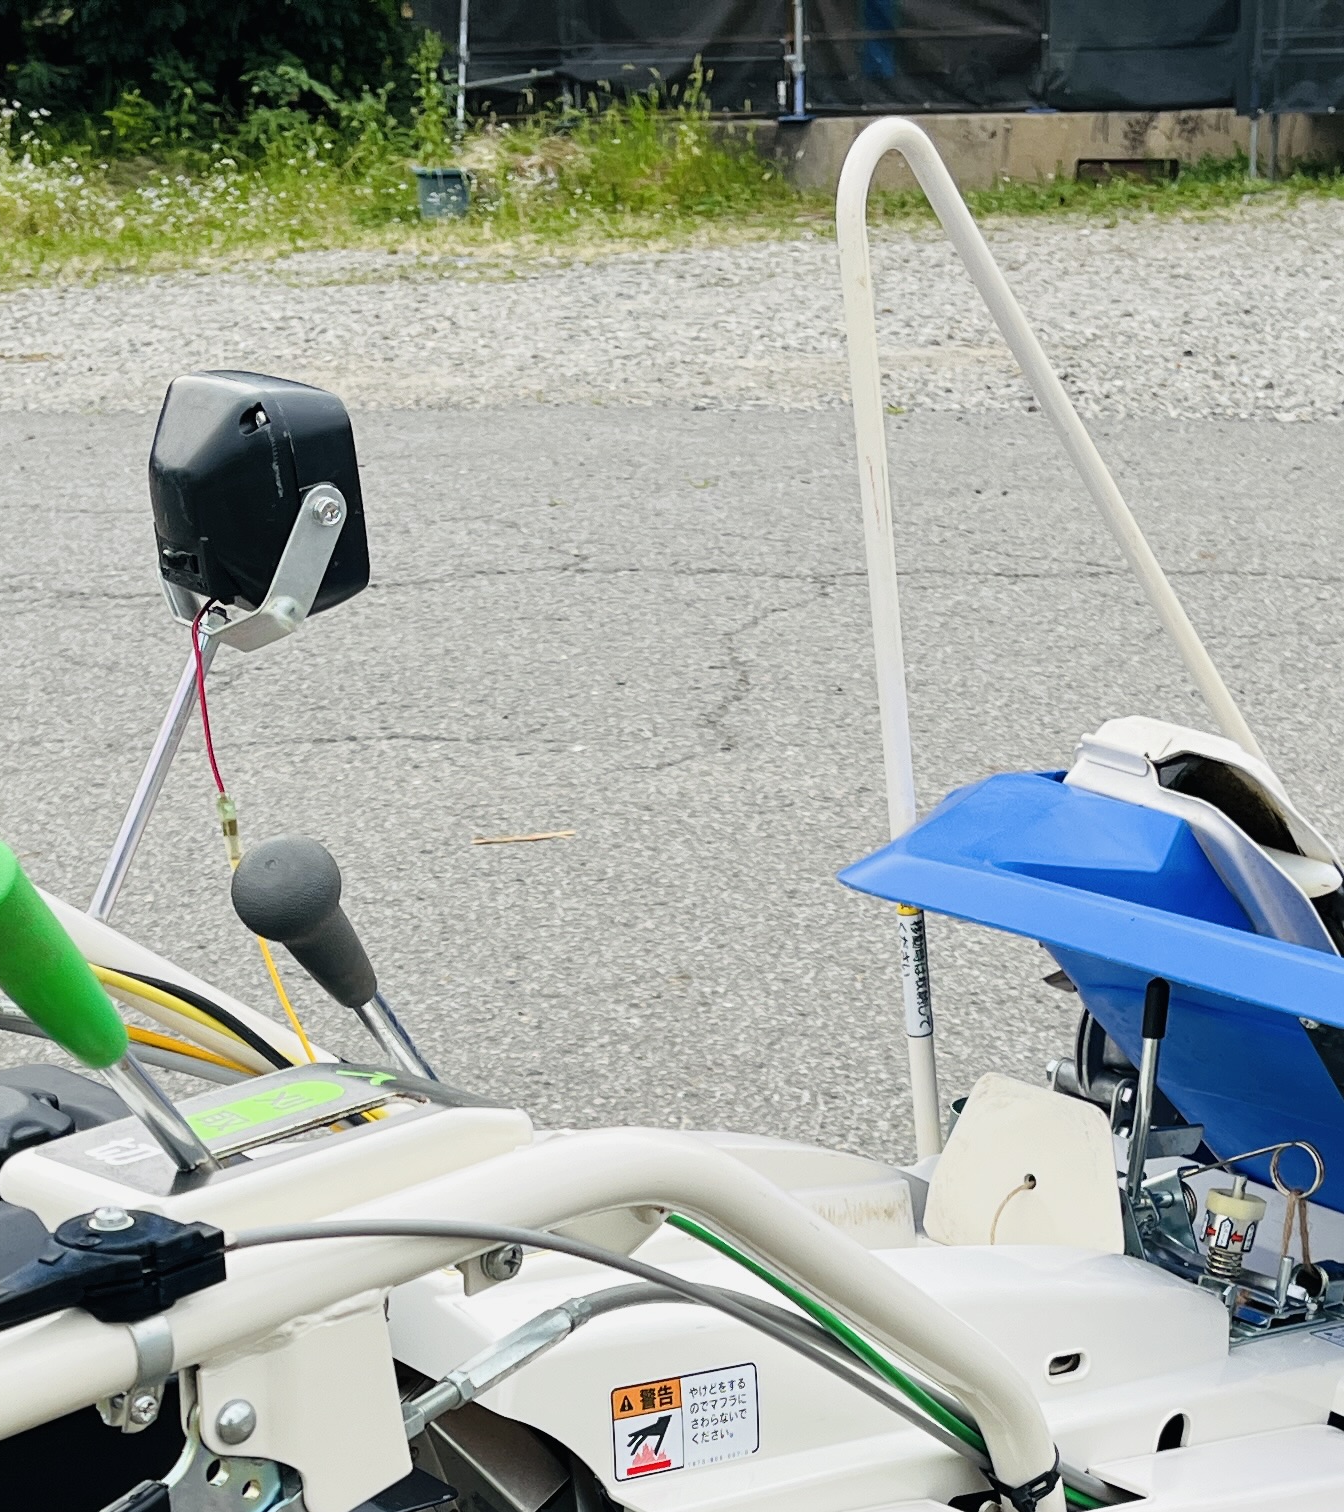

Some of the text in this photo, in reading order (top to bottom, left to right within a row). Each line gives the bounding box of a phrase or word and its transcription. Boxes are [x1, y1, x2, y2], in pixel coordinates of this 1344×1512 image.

[639, 1384, 674, 1411] 警告
[689, 1378, 746, 1399] やけどをする
[689, 1393, 747, 1415] のでマフラに
[691, 1409, 747, 1430] さわらないで
[691, 1429, 734, 1445] ください。
